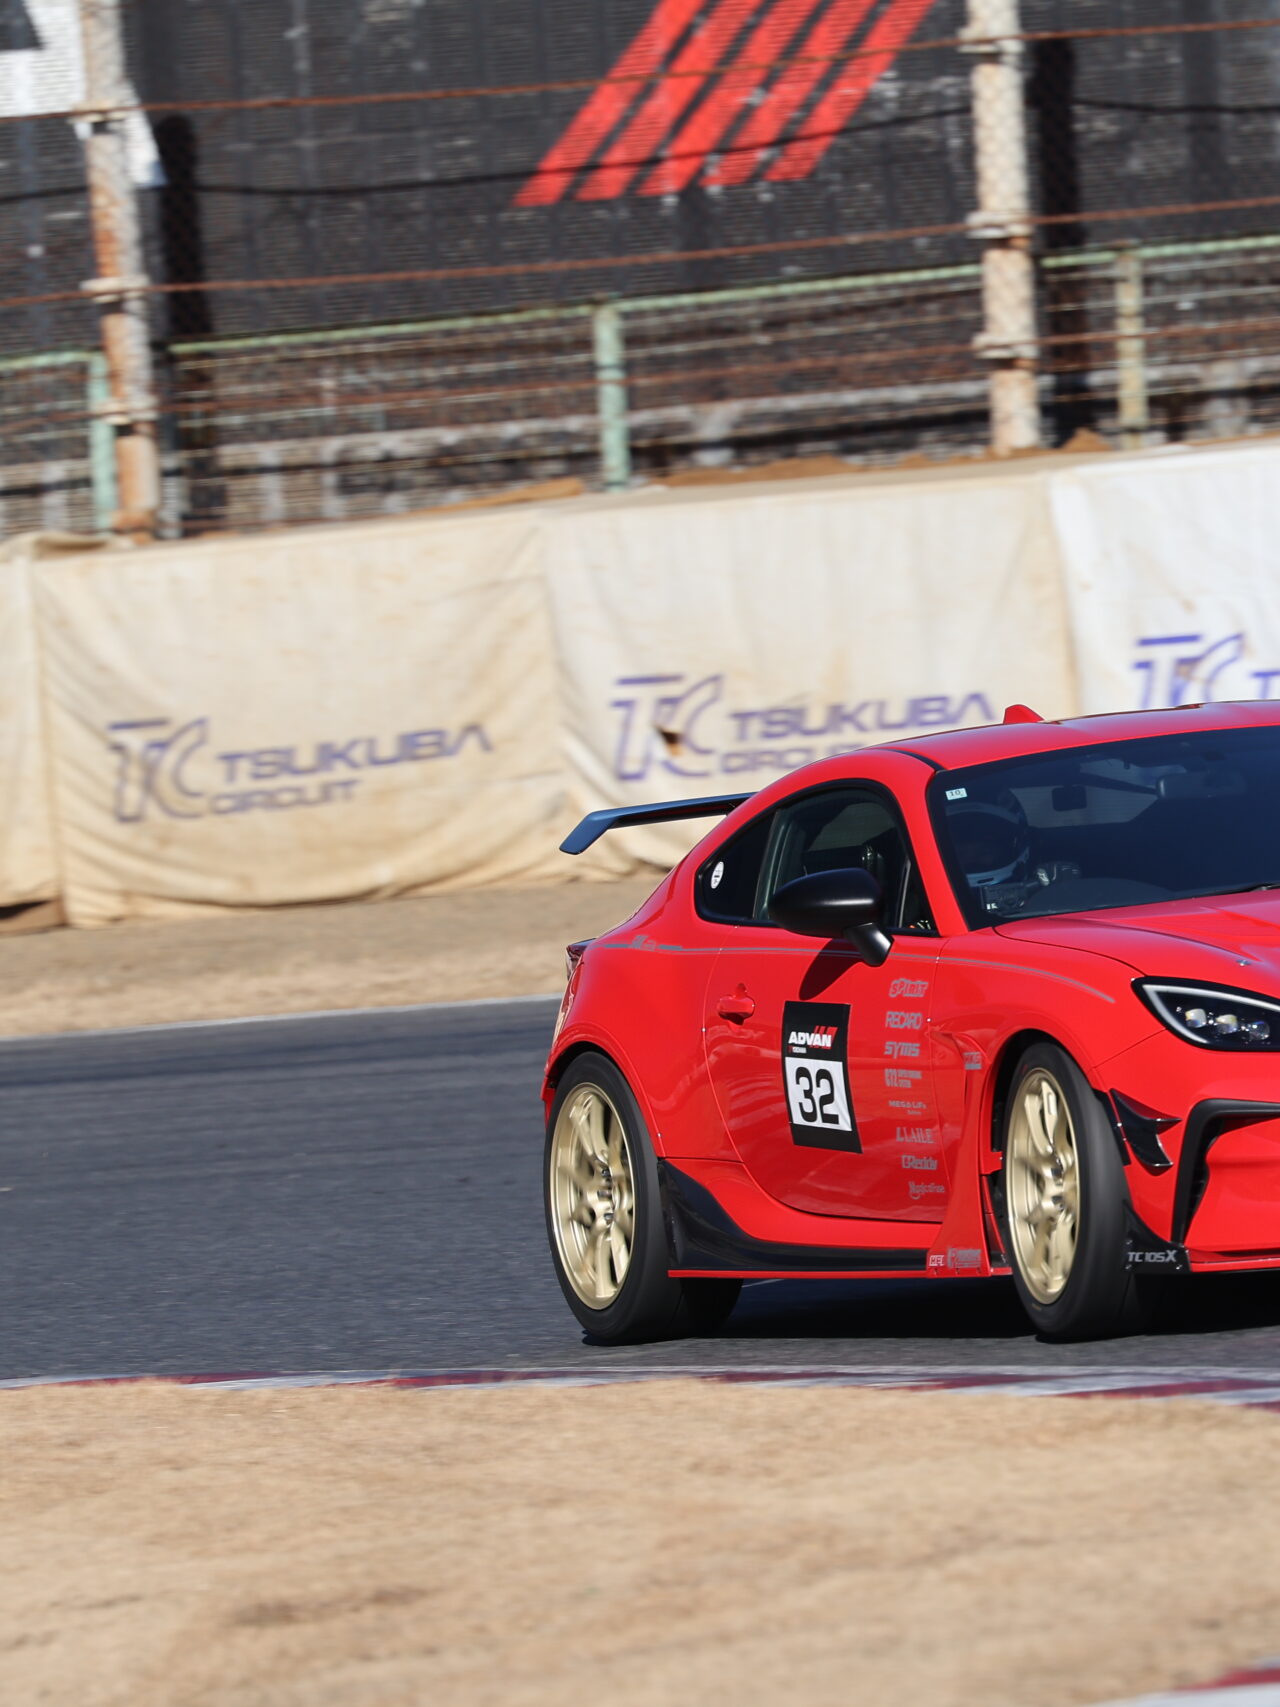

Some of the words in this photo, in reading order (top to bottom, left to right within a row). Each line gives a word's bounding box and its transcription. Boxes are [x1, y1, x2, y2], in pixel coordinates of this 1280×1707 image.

[727, 692, 998, 742] TSUKUBA
[215, 723, 494, 783] TSUKUBA
[788, 1030, 832, 1048] ADVAN
[885, 1010, 923, 1030] RECARO
[795, 1066, 840, 1125] 32
